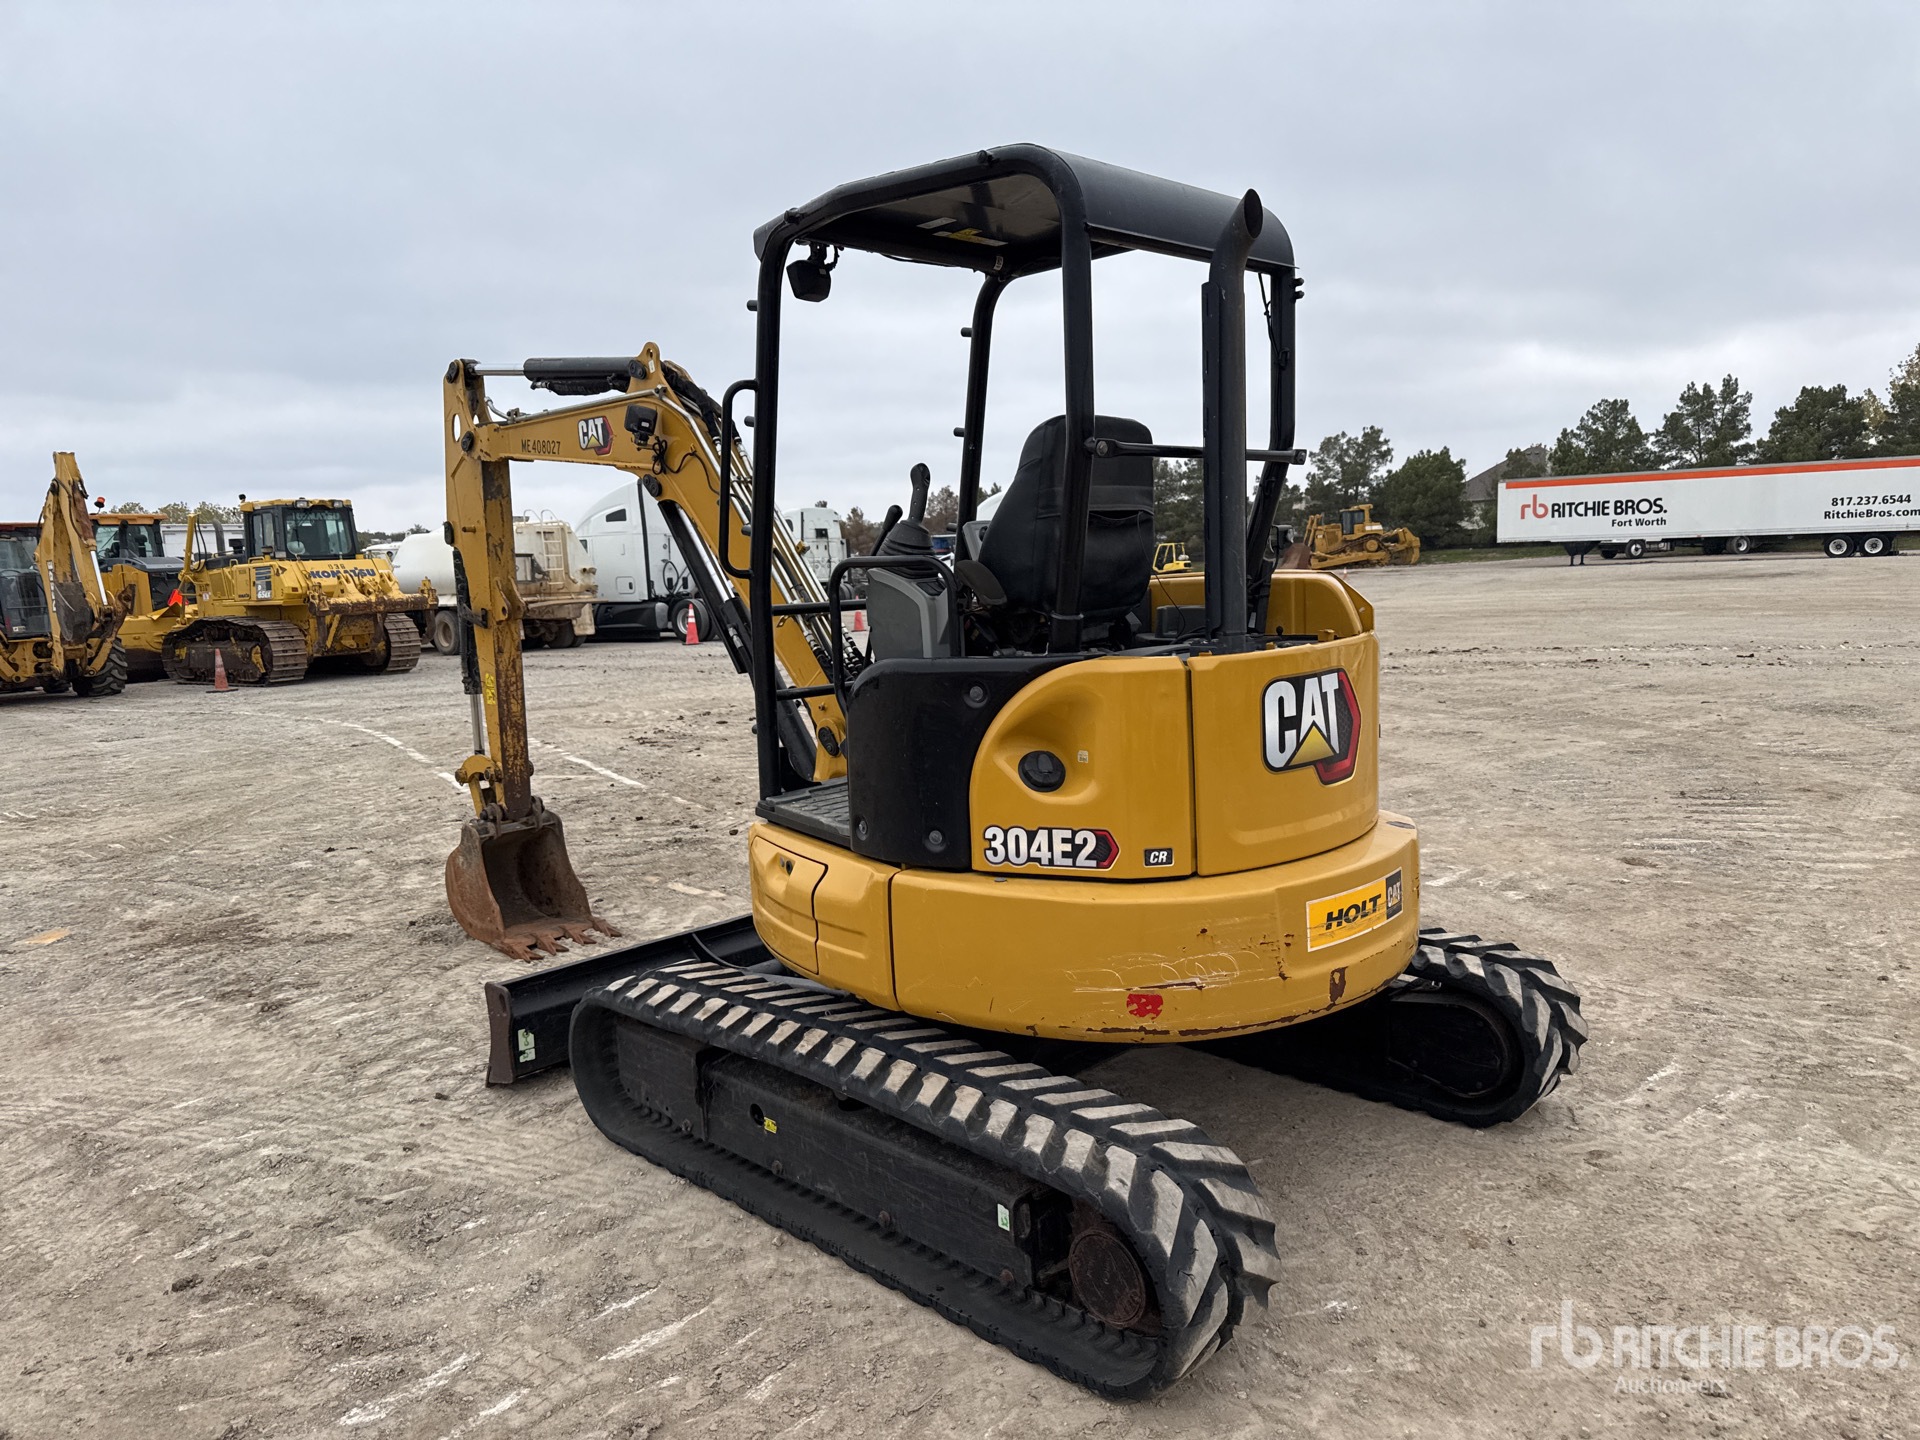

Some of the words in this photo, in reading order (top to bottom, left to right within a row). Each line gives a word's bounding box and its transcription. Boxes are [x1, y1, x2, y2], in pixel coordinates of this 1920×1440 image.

[579, 417, 604, 449] CAT
[521, 440, 561, 455] ME408027
[1551, 500, 1610, 519] RITCHIE
[1613, 497, 1668, 516] BROS.
[1831, 494, 1911, 507] 817.237.6544
[1611, 518, 1633, 528] Fort
[1634, 517, 1667, 527] Worth
[1824, 508, 1920, 520] RitchieBros.com
[1265, 672, 1339, 768] CAT
[984, 826, 1097, 867] 304E2
[1149, 850, 1167, 864] CR
[1325, 894, 1381, 931] HOLT
[1386, 881, 1401, 908] CAT
